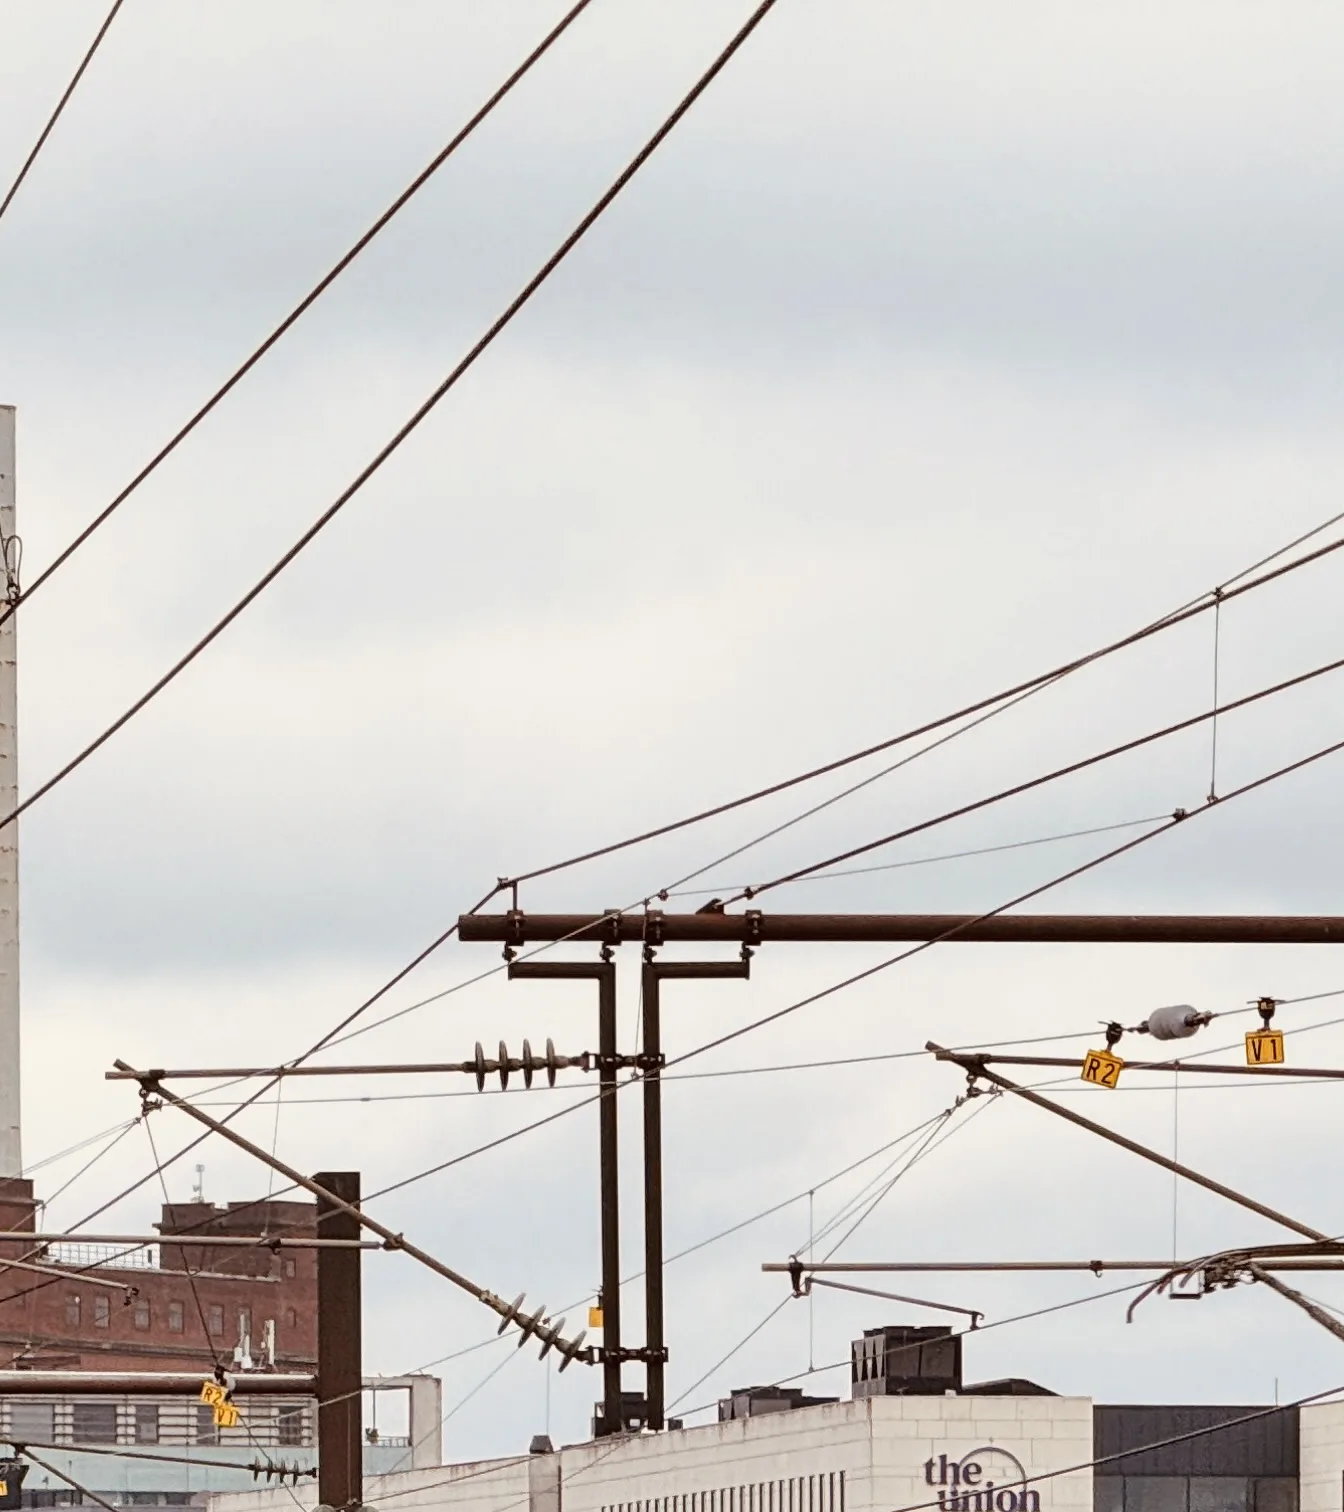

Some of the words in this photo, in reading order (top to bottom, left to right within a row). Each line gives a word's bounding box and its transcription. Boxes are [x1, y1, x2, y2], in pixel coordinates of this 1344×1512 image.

[1251, 1039, 1277, 1062] V1
[1086, 1058, 1115, 1084] R2
[923, 1454, 982, 1486] the
